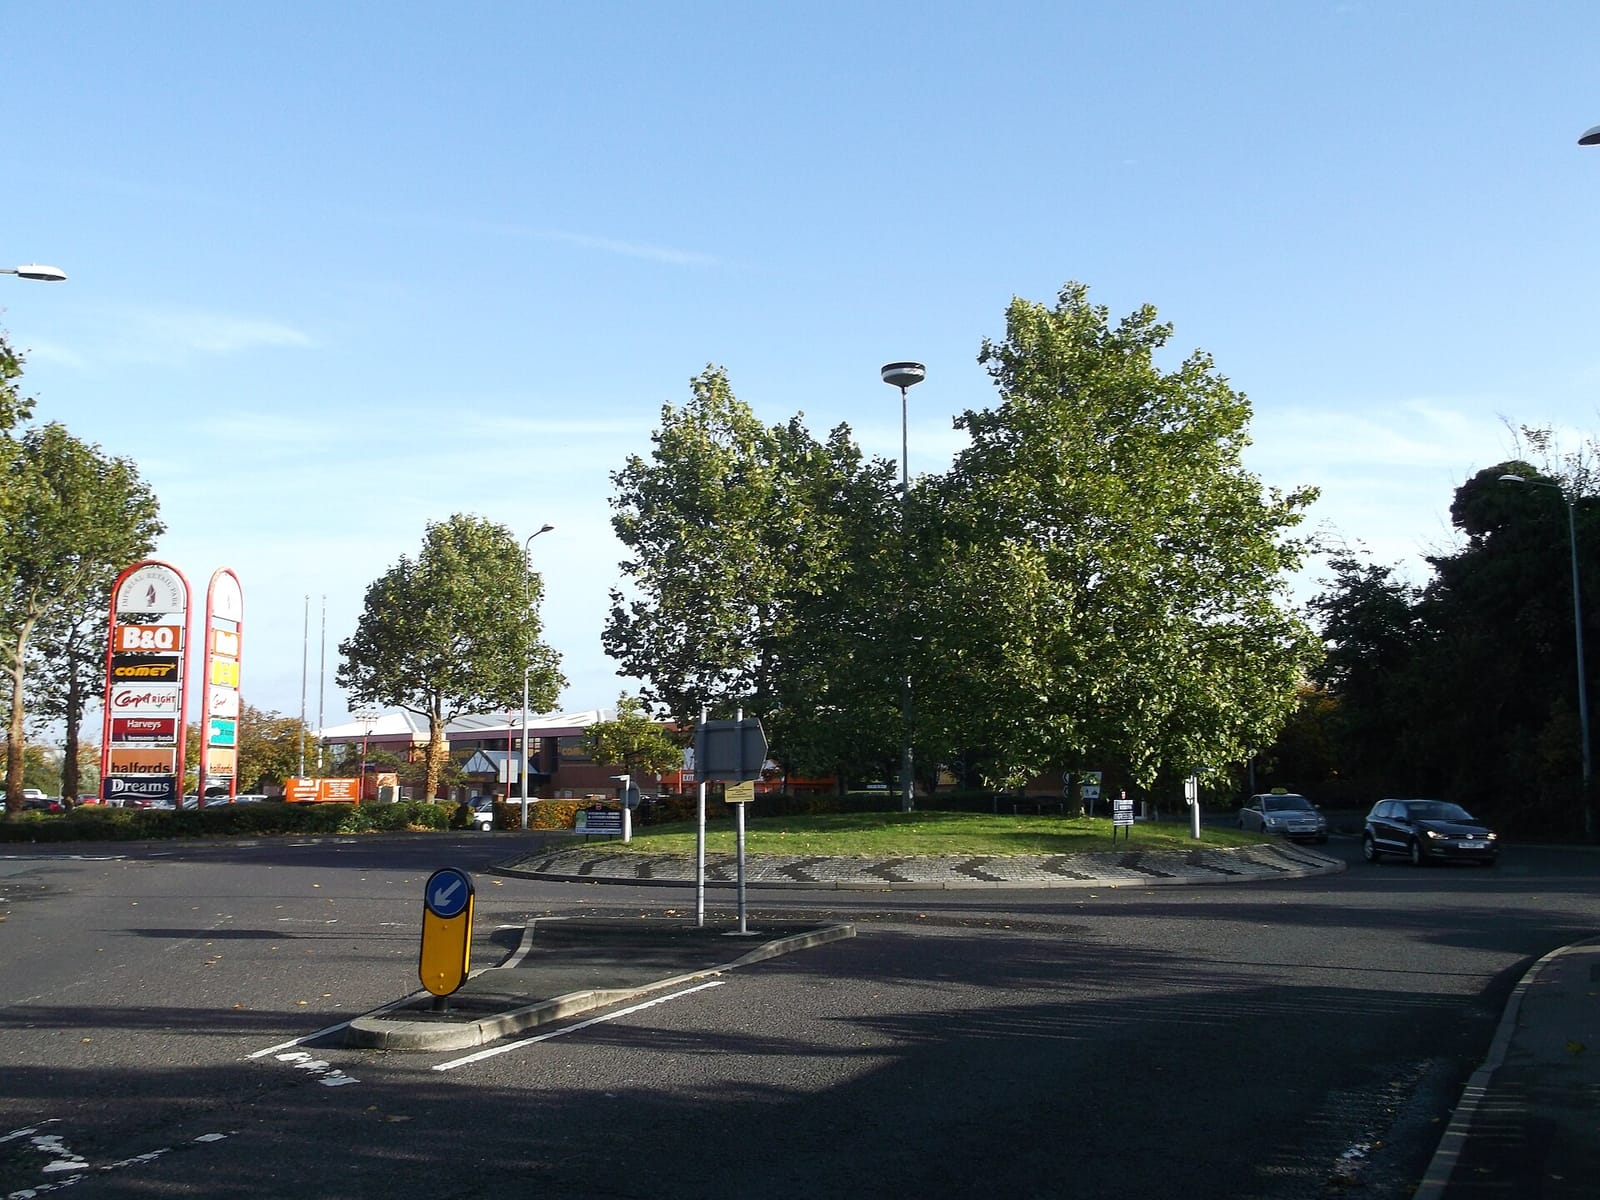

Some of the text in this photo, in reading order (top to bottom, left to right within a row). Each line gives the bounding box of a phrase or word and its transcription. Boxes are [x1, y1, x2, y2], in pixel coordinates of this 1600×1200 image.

[146, 572, 172, 588] RETAIL
[122, 627, 174, 649] B&Q
[127, 720, 162, 731] Harveys
[111, 762, 171, 774] halfords
[111, 779, 170, 792] Dreams
